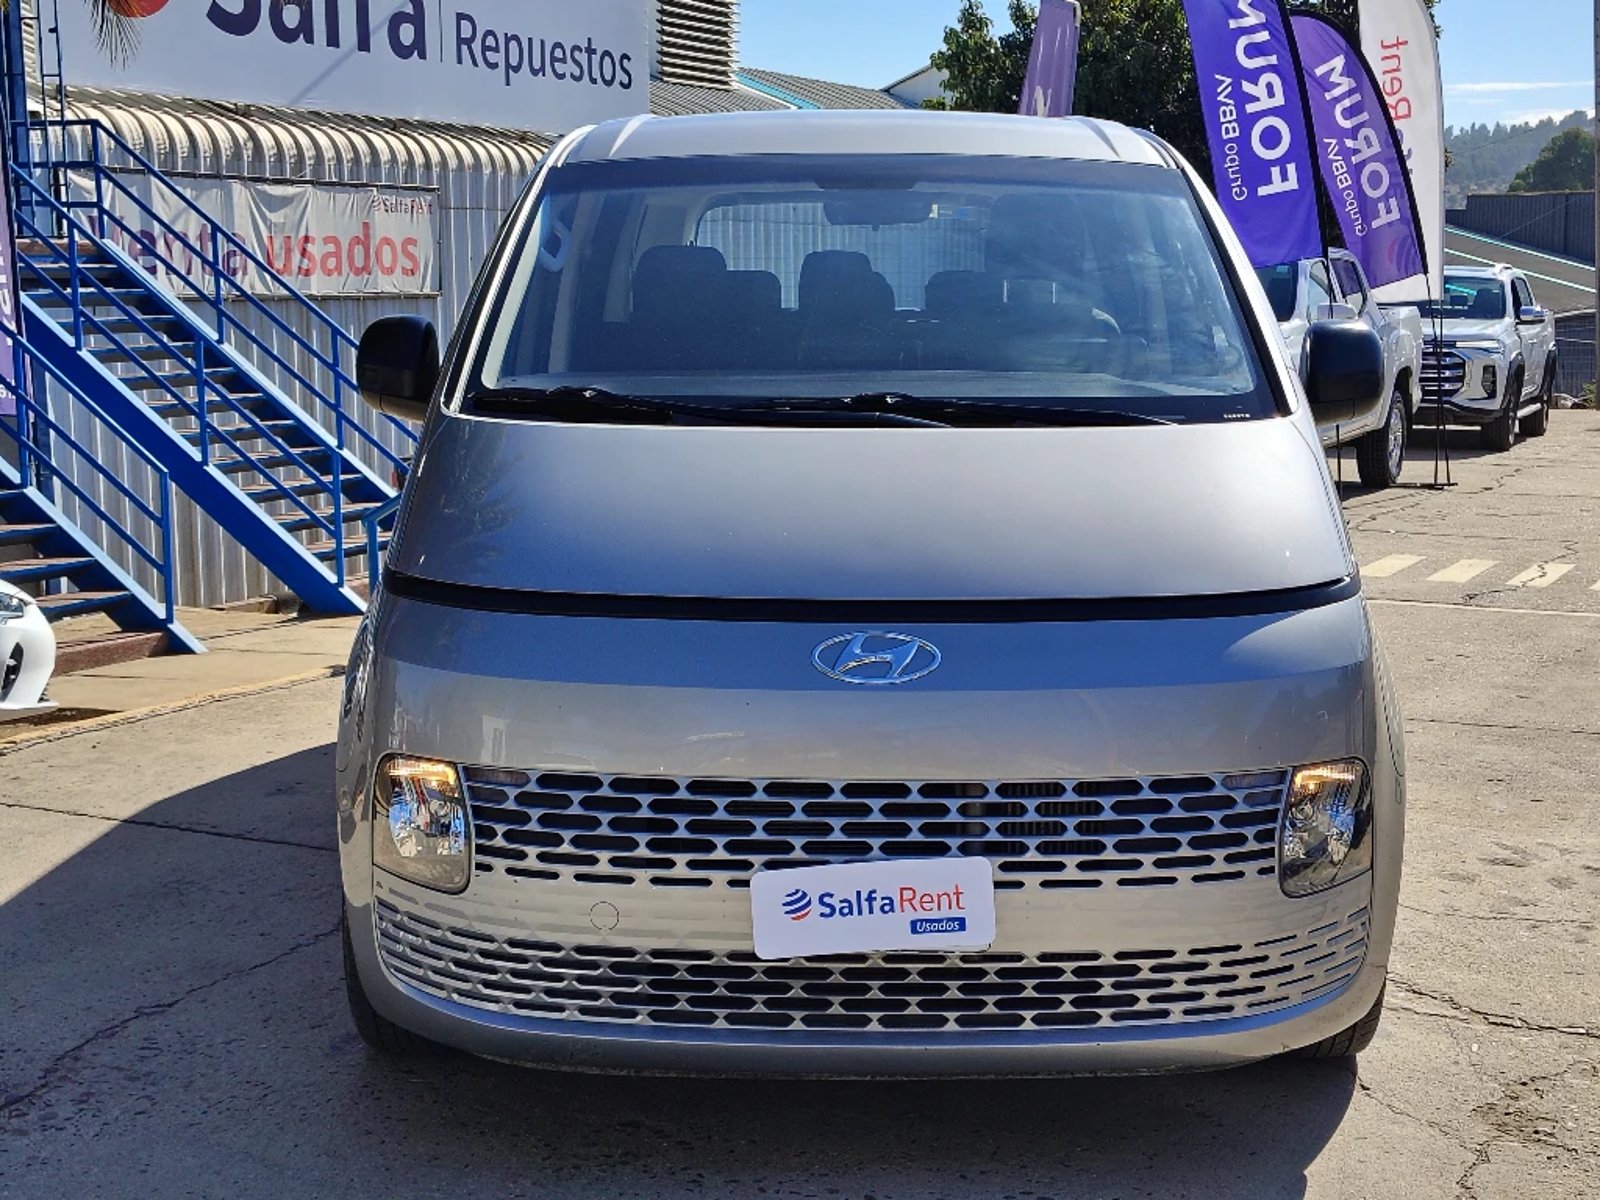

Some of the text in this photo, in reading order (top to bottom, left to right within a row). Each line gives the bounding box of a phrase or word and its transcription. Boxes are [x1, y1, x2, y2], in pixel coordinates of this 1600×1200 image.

[455, 12, 632, 90] Repuestos
[266, 221, 420, 277] usados
[818, 884, 966, 919] SalfaRent
[916, 919, 960, 933] Usados
